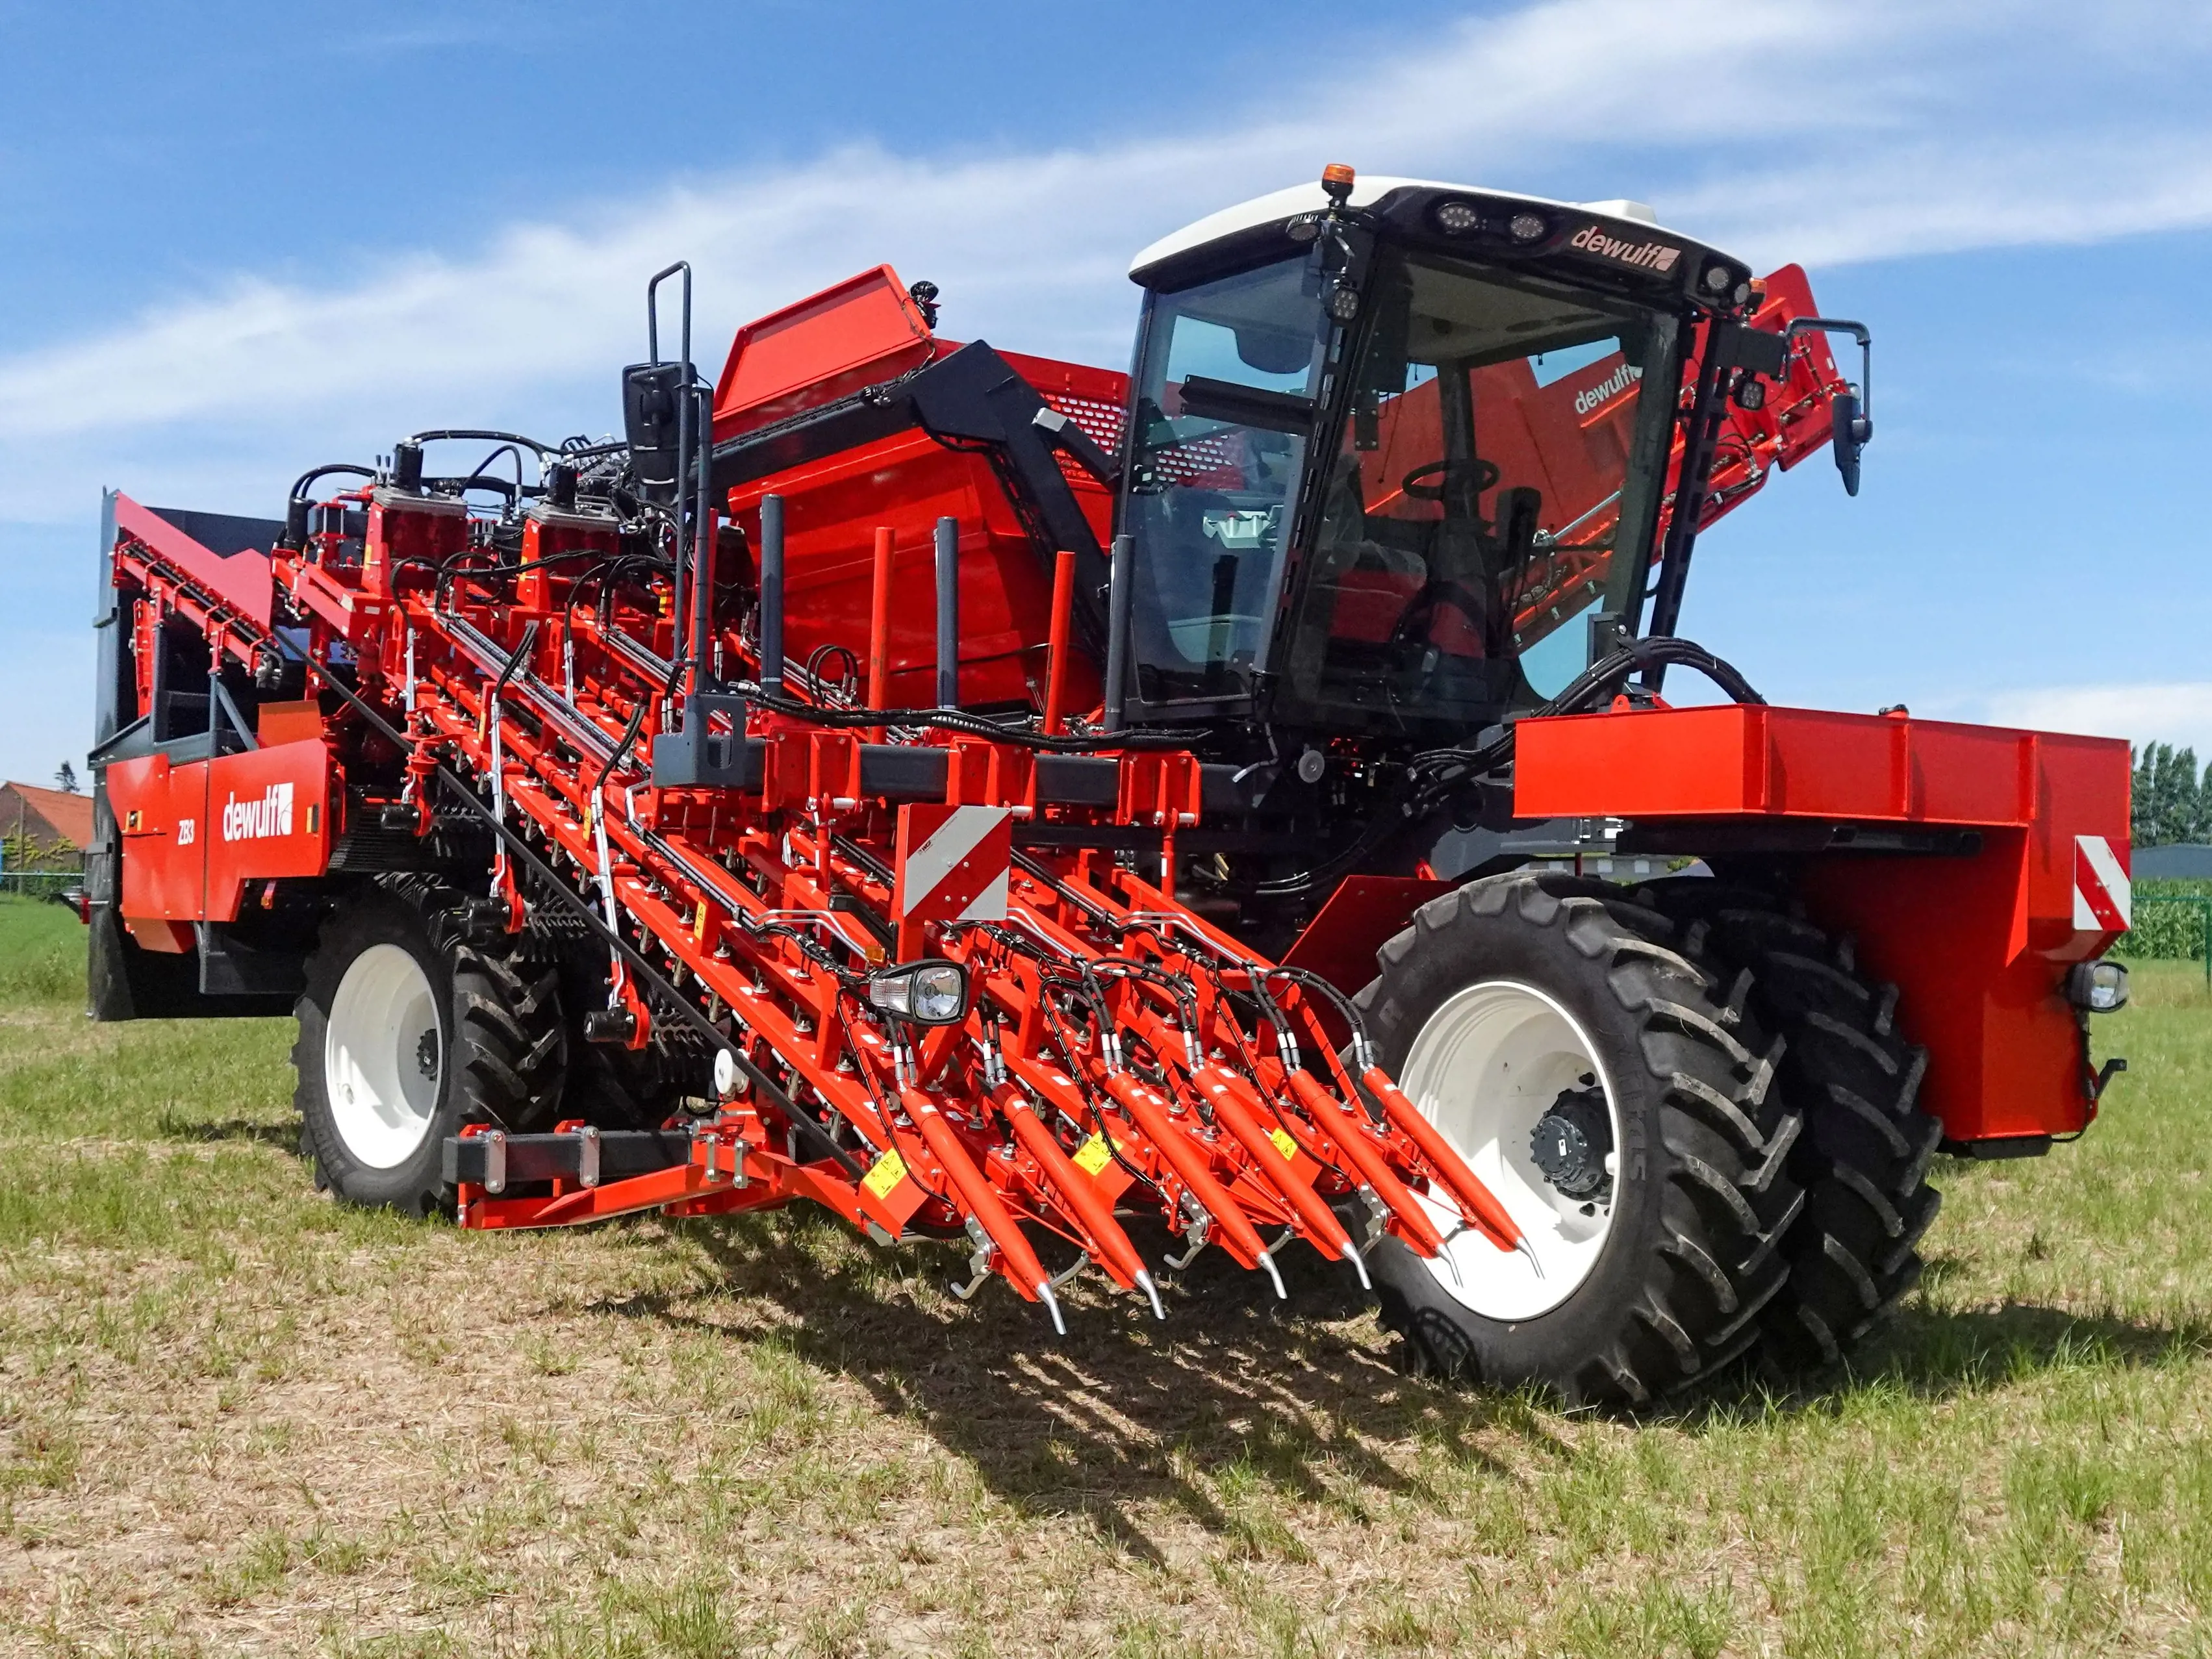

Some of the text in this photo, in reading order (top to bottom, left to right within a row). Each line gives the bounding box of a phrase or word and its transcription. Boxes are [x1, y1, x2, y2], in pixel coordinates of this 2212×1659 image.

[1571, 225, 1663, 268] dewulf
[1575, 363, 1631, 414] dewulf
[177, 818, 195, 845] ZB3
[223, 784, 279, 842] dewulf
